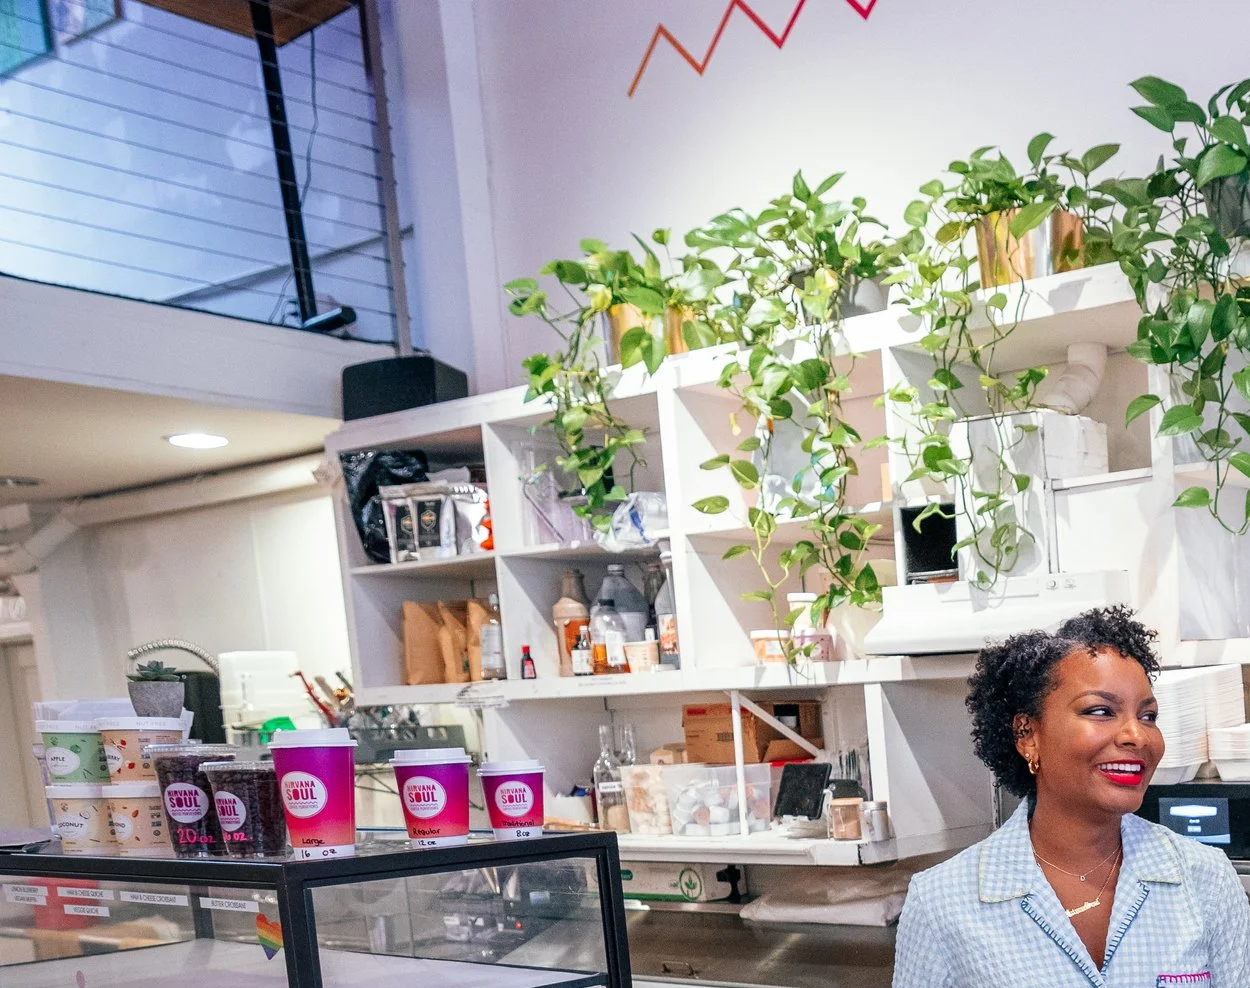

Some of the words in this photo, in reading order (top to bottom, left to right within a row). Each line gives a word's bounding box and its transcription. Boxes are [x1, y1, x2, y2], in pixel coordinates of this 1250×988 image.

[284, 780, 316, 789] NIRVANA
[407, 785, 436, 793] NIRVANA
[167, 789, 199, 798] NIRVANA
[286, 788, 317, 801] SOUL
[409, 791, 438, 803] SOUL
[170, 797, 200, 808] SOUL
[501, 794, 528, 804] SOUL
[217, 805, 239, 817] SOUL
[177, 828, 197, 844] 20
[412, 828, 441, 836] Regular
[302, 837, 325, 846] Large
[301, 849, 310, 859] 16
